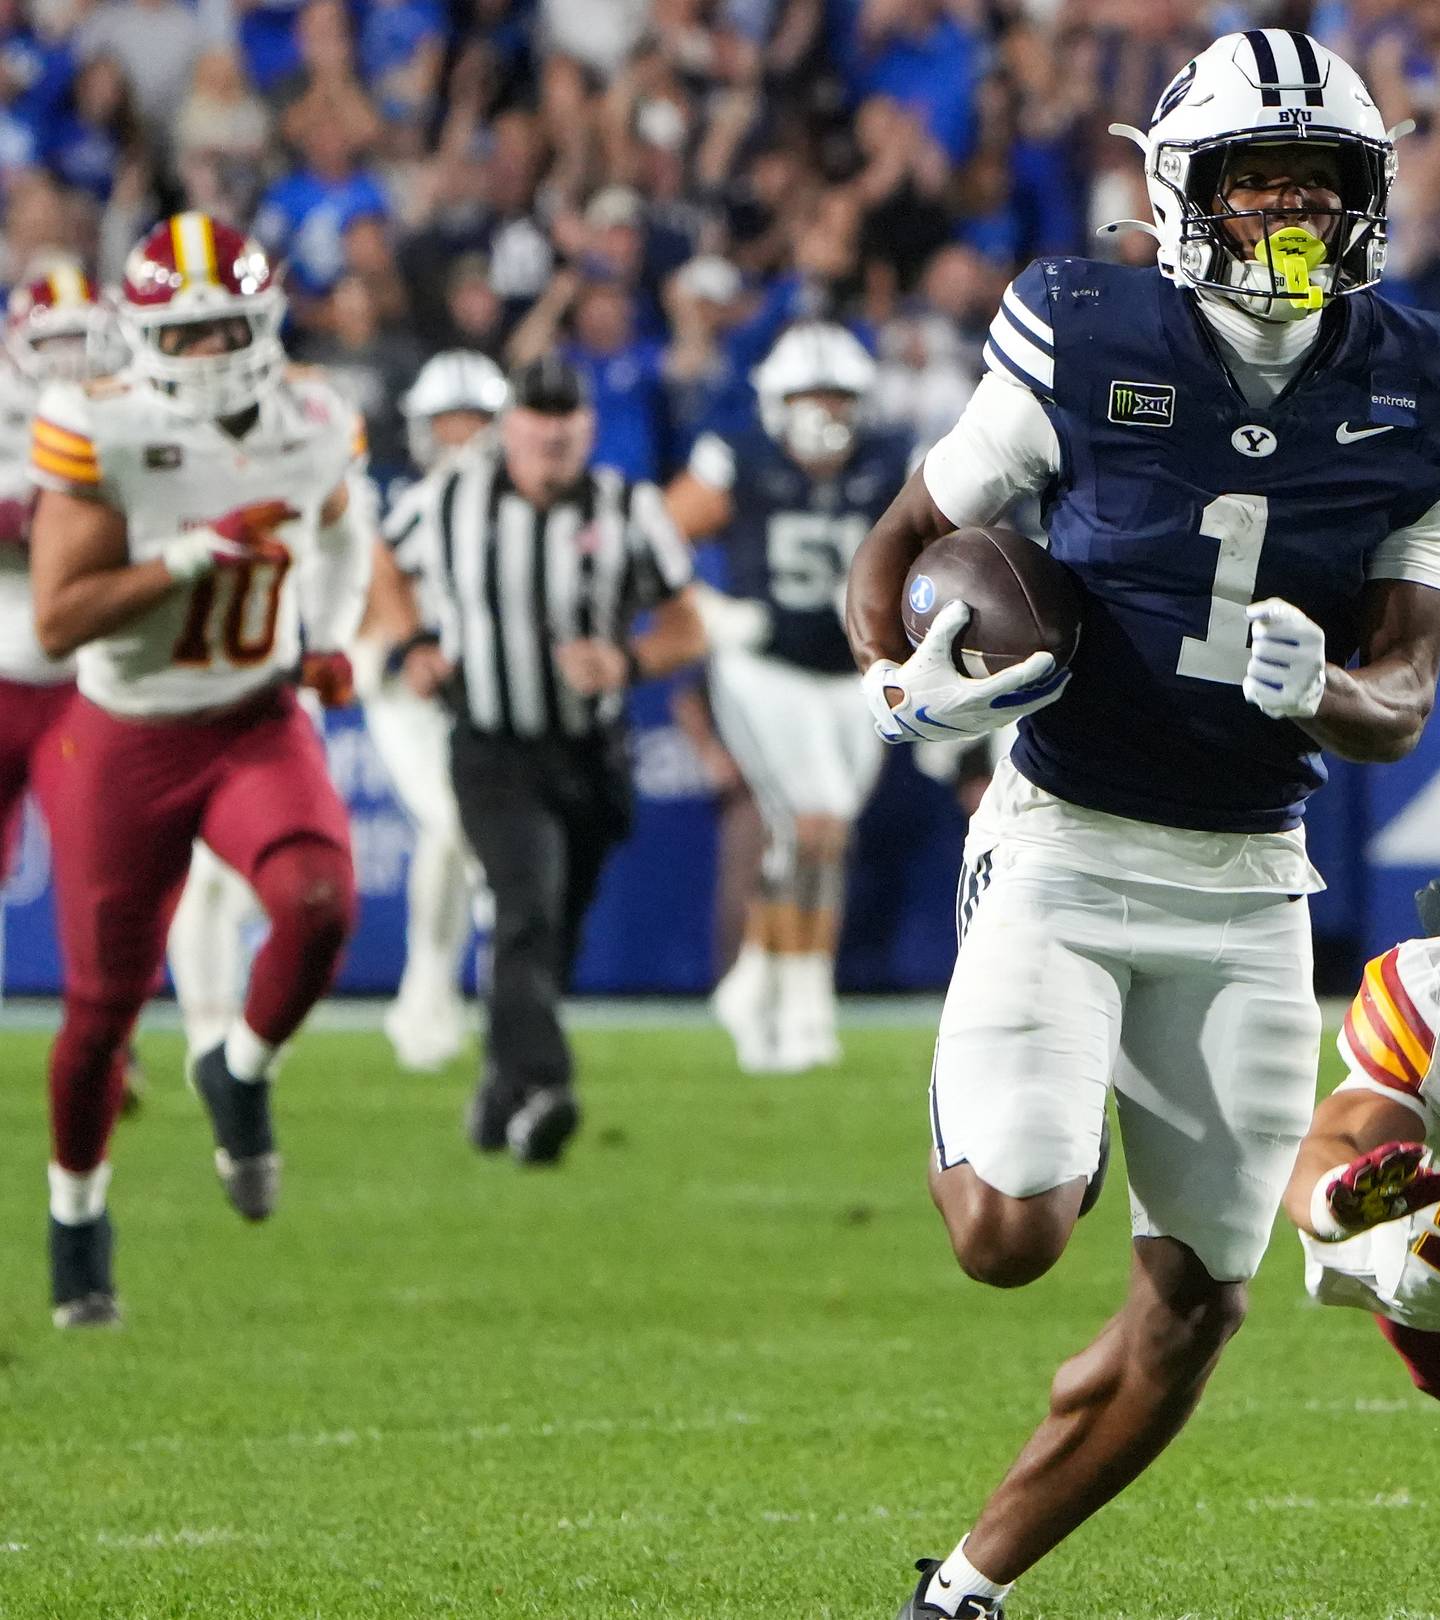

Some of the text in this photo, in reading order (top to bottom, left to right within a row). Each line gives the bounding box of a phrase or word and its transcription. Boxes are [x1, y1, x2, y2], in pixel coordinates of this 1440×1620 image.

[1279, 108, 1312, 124] BYU
[1371, 394, 1417, 409] entrata
[1241, 430, 1270, 453] Y
[1175, 493, 1268, 686] 1
[171, 554, 291, 669] 10
